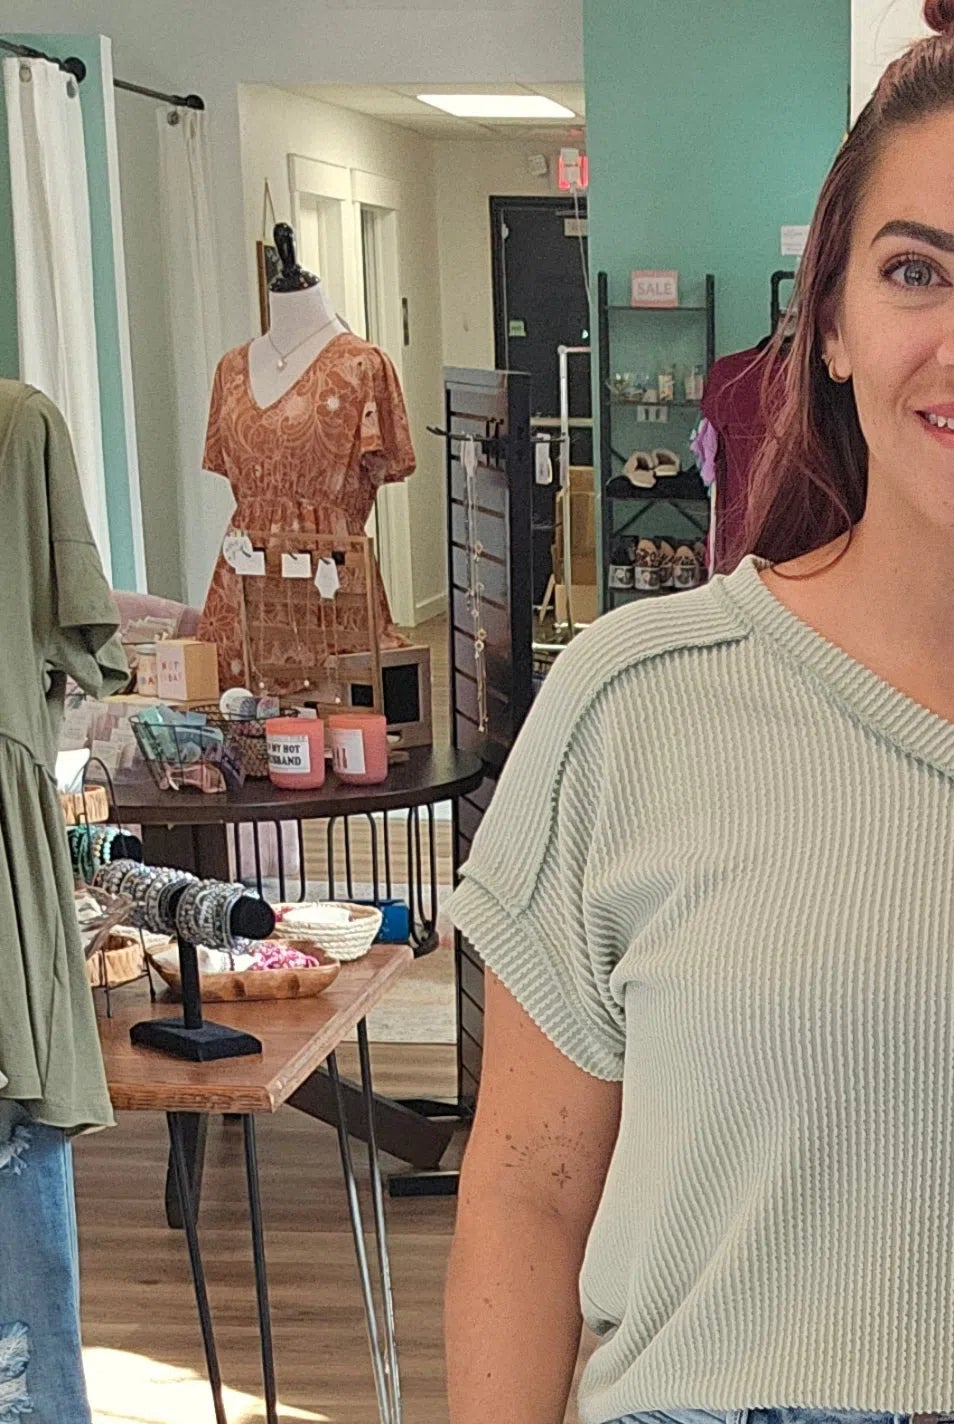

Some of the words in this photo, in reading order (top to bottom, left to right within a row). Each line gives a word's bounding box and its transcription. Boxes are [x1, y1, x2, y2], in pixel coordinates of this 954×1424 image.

[637, 282, 673, 296] SALE
[283, 744, 300, 754] HOT
[269, 755, 302, 766] SBAND
